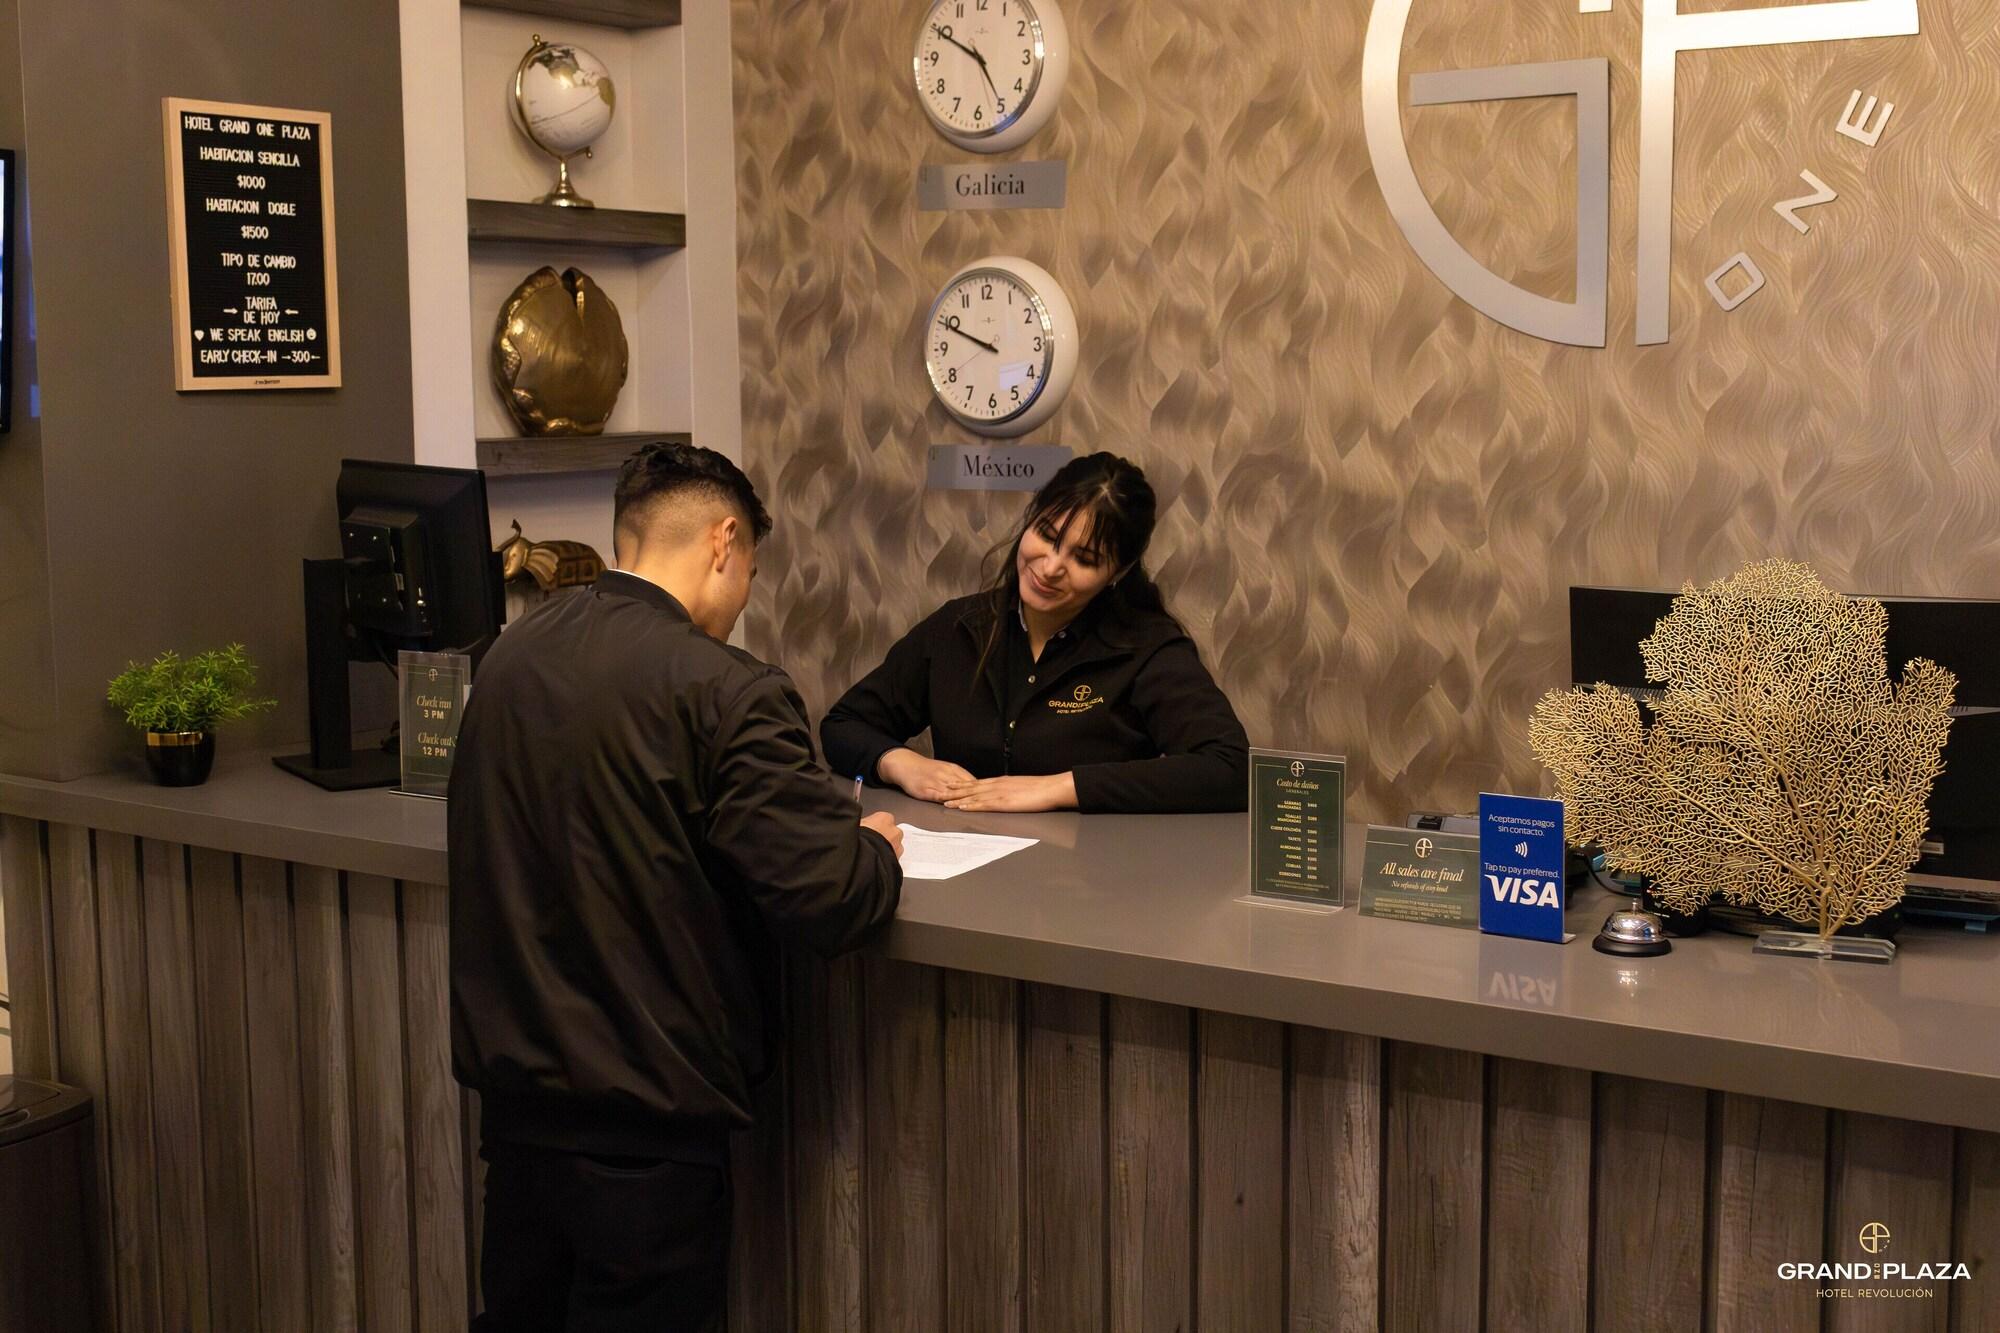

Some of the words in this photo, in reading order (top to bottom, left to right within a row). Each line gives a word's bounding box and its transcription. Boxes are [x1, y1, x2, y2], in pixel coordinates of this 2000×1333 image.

[956, 3, 964, 18] 11
[1002, 2, 1007, 17] 1
[1017, 20, 1025, 37] 2
[930, 51, 939, 67] 9
[1022, 49, 1031, 65] 3
[936, 78, 945, 94] 8
[1014, 77, 1023, 94] 4
[952, 97, 962, 113] 7
[974, 105, 982, 121] 6
[996, 97, 1005, 114] 5
[185, 115, 214, 132] HOTEL
[219, 119, 250, 134] GRAND
[256, 122, 275, 137] ONE
[282, 125, 311, 140] PLAZA
[200, 146, 254, 163] HABITACION
[258, 151, 300, 167] SENCILLA
[236, 174, 266, 189] $1000
[955, 173, 1025, 197] Galicia
[206, 198, 259, 214] HABITACION
[268, 202, 296, 216] DOBLE
[240, 225, 269, 240] $1500
[221, 252, 244, 267] TIPO
[248, 254, 260, 268] DE
[263, 255, 296, 269] CAMBIO
[246, 272, 270, 286] 17.00
[981, 284, 993, 301] 12
[1008, 291, 1012, 305] 1
[245, 296, 278, 310] TARIFA
[961, 293, 970, 309] 11
[243, 311, 256, 324] DE
[260, 311, 280, 325] HOY
[1023, 308, 1032, 324] 2
[210, 328, 224, 341] WE
[227, 328, 261, 342] SPEAK
[268, 329, 304, 342] ENGLISH
[940, 341, 949, 357] 9
[1033, 336, 1042, 352] 3
[200, 349, 230, 363] EARLY
[231, 350, 277, 363] CHECK-IN
[948, 367, 957, 383] 8
[1026, 364, 1035, 380] 4
[965, 385, 974, 401] 7
[988, 393, 997, 409] 6
[1010, 386, 1019, 401] 5
[963, 454, 1035, 479] México
[424, 709, 429, 718] 3
[431, 710, 444, 720] PM
[422, 746, 433, 756] 12
[435, 747, 447, 757] PM
[1488, 813, 1532, 827] Aceptamos
[1532, 818, 1556, 829] pagos
[1498, 825, 1510, 833] sin
[1510, 826, 1545, 836] contacto.
[1380, 862, 1397, 875] All
[1396, 864, 1420, 878] sales
[1420, 870, 1438, 880] are
[1436, 867, 1465, 884] final
[1484, 862, 1499, 873] Tap
[1499, 865, 1507, 873] to
[1507, 867, 1522, 876] pay
[1522, 867, 1560, 879] preferred.
[1484, 874, 1559, 909] VISA
